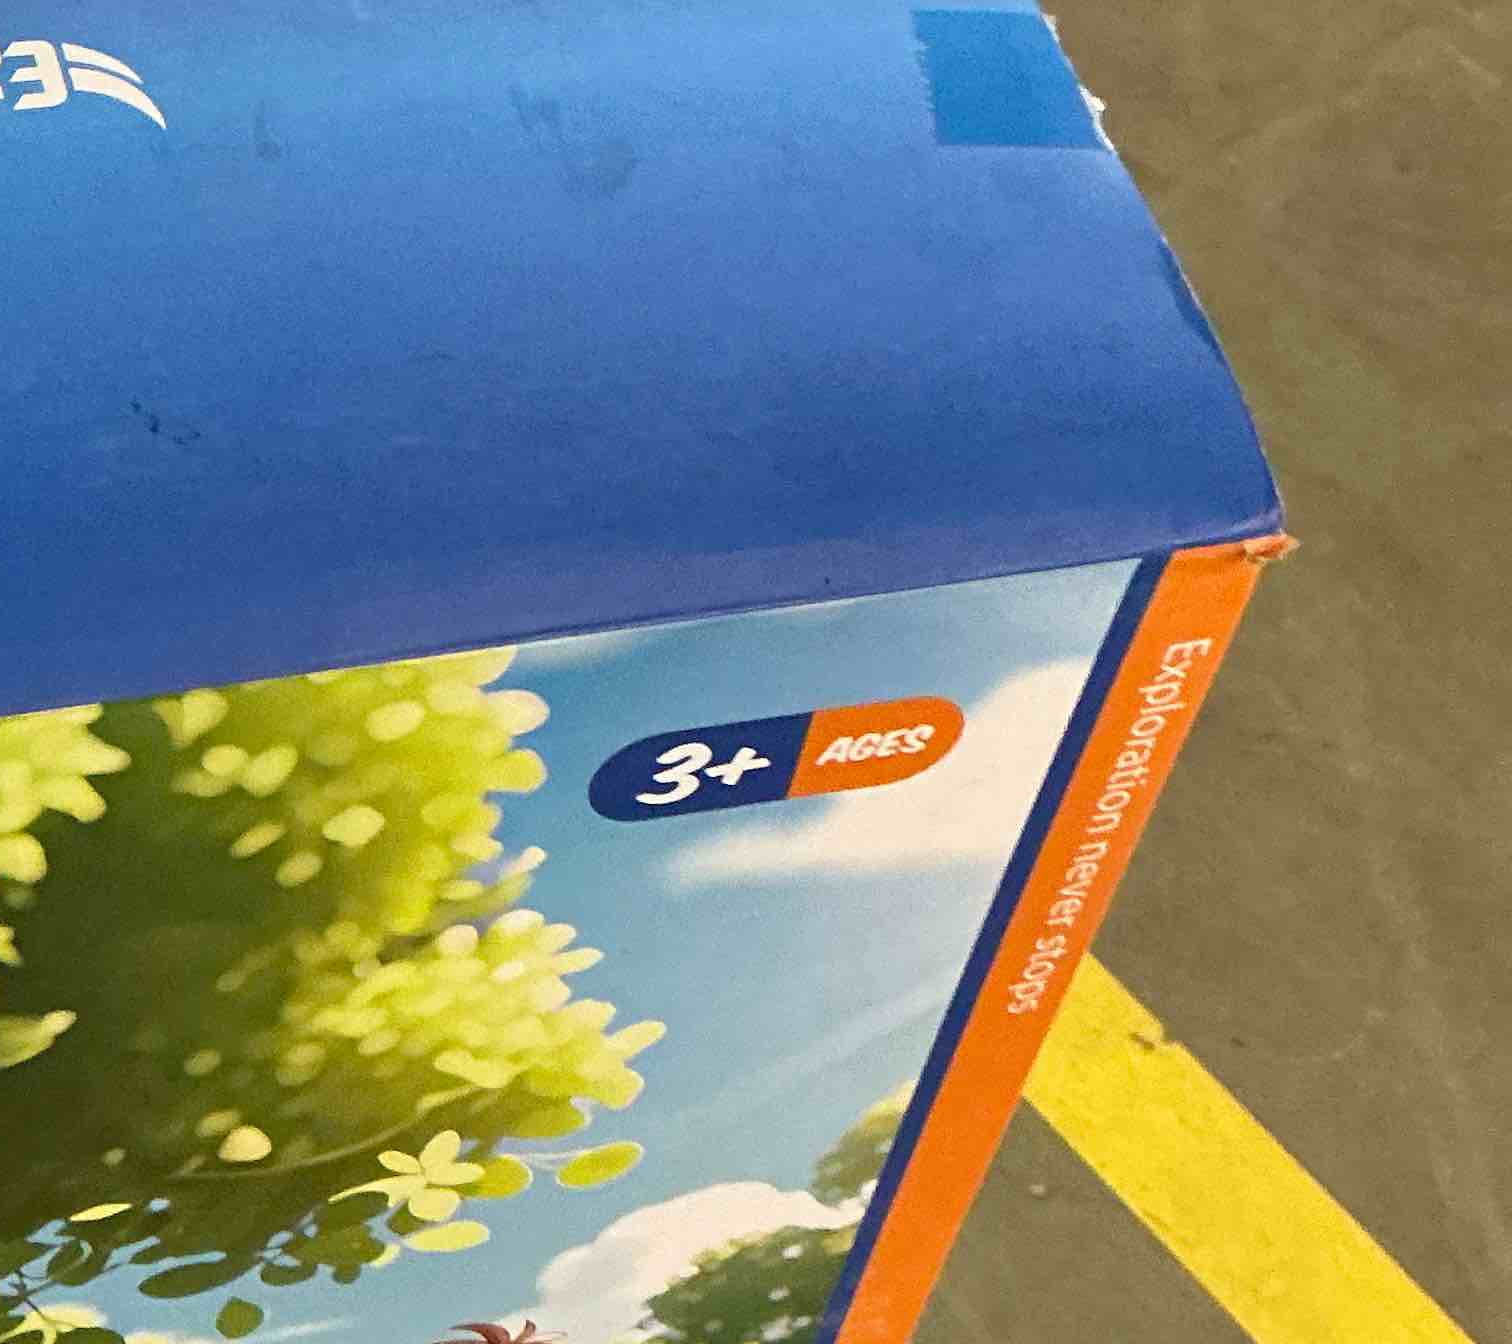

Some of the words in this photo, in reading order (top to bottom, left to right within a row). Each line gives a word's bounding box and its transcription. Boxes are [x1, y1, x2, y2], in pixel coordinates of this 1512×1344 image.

[636, 741, 772, 806] 3+
[814, 723, 936, 767] AGES
[1085, 637, 1213, 834] Exploration
[1045, 840, 1109, 927] never
[1006, 933, 1068, 1014] stops
